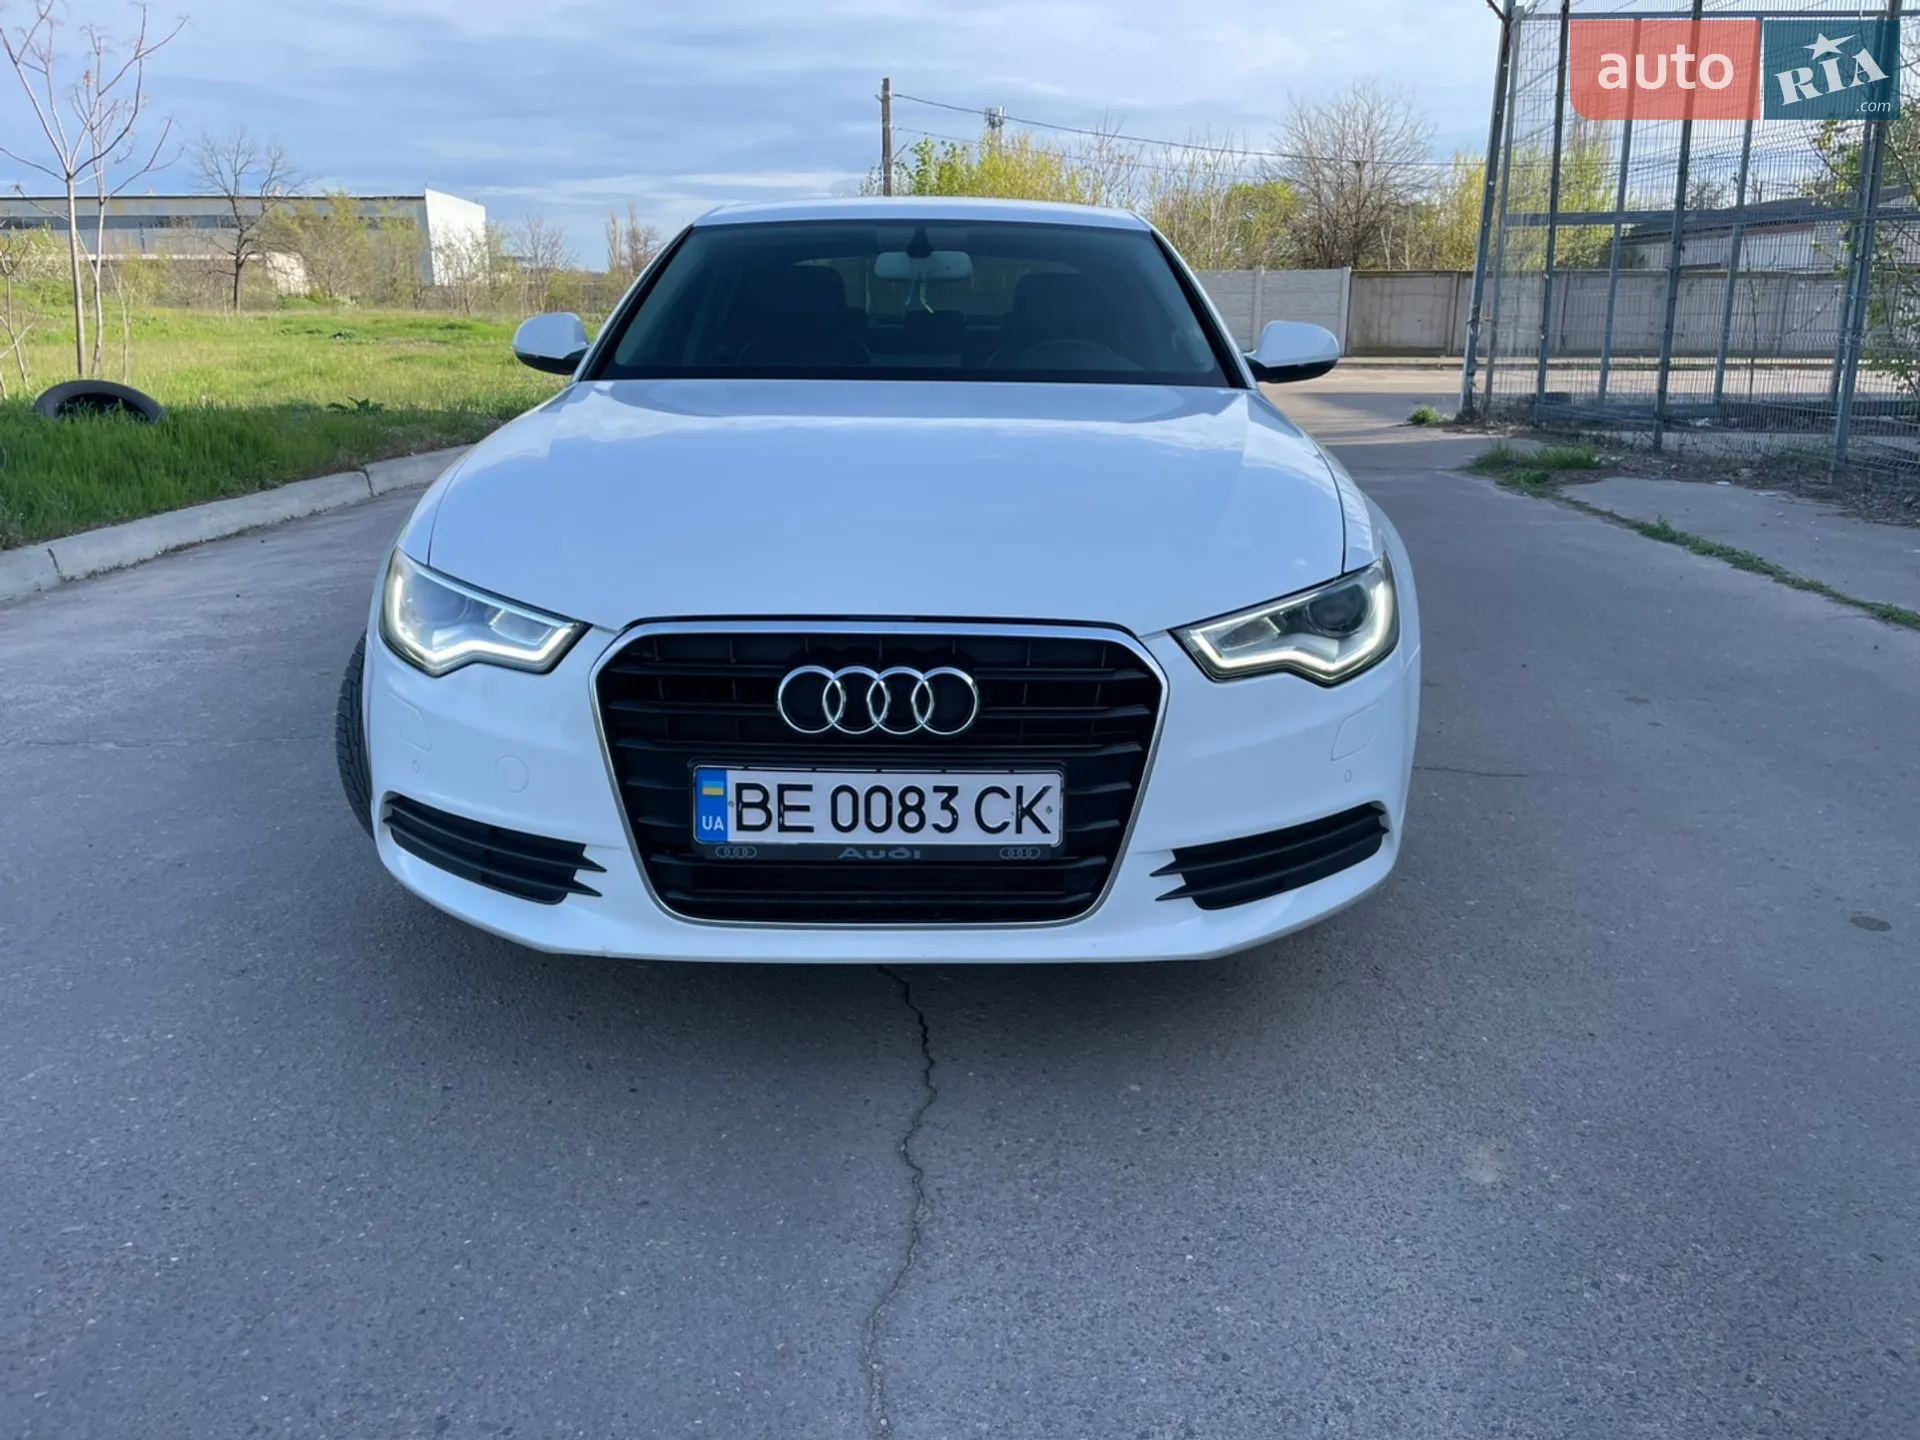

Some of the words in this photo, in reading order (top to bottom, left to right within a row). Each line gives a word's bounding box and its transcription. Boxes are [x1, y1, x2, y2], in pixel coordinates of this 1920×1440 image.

[735, 782, 815, 833] BE
[830, 784, 959, 834] 0083
[974, 785, 1052, 834] CK
[702, 816, 724, 831] UA
[838, 847, 921, 860] Audi
